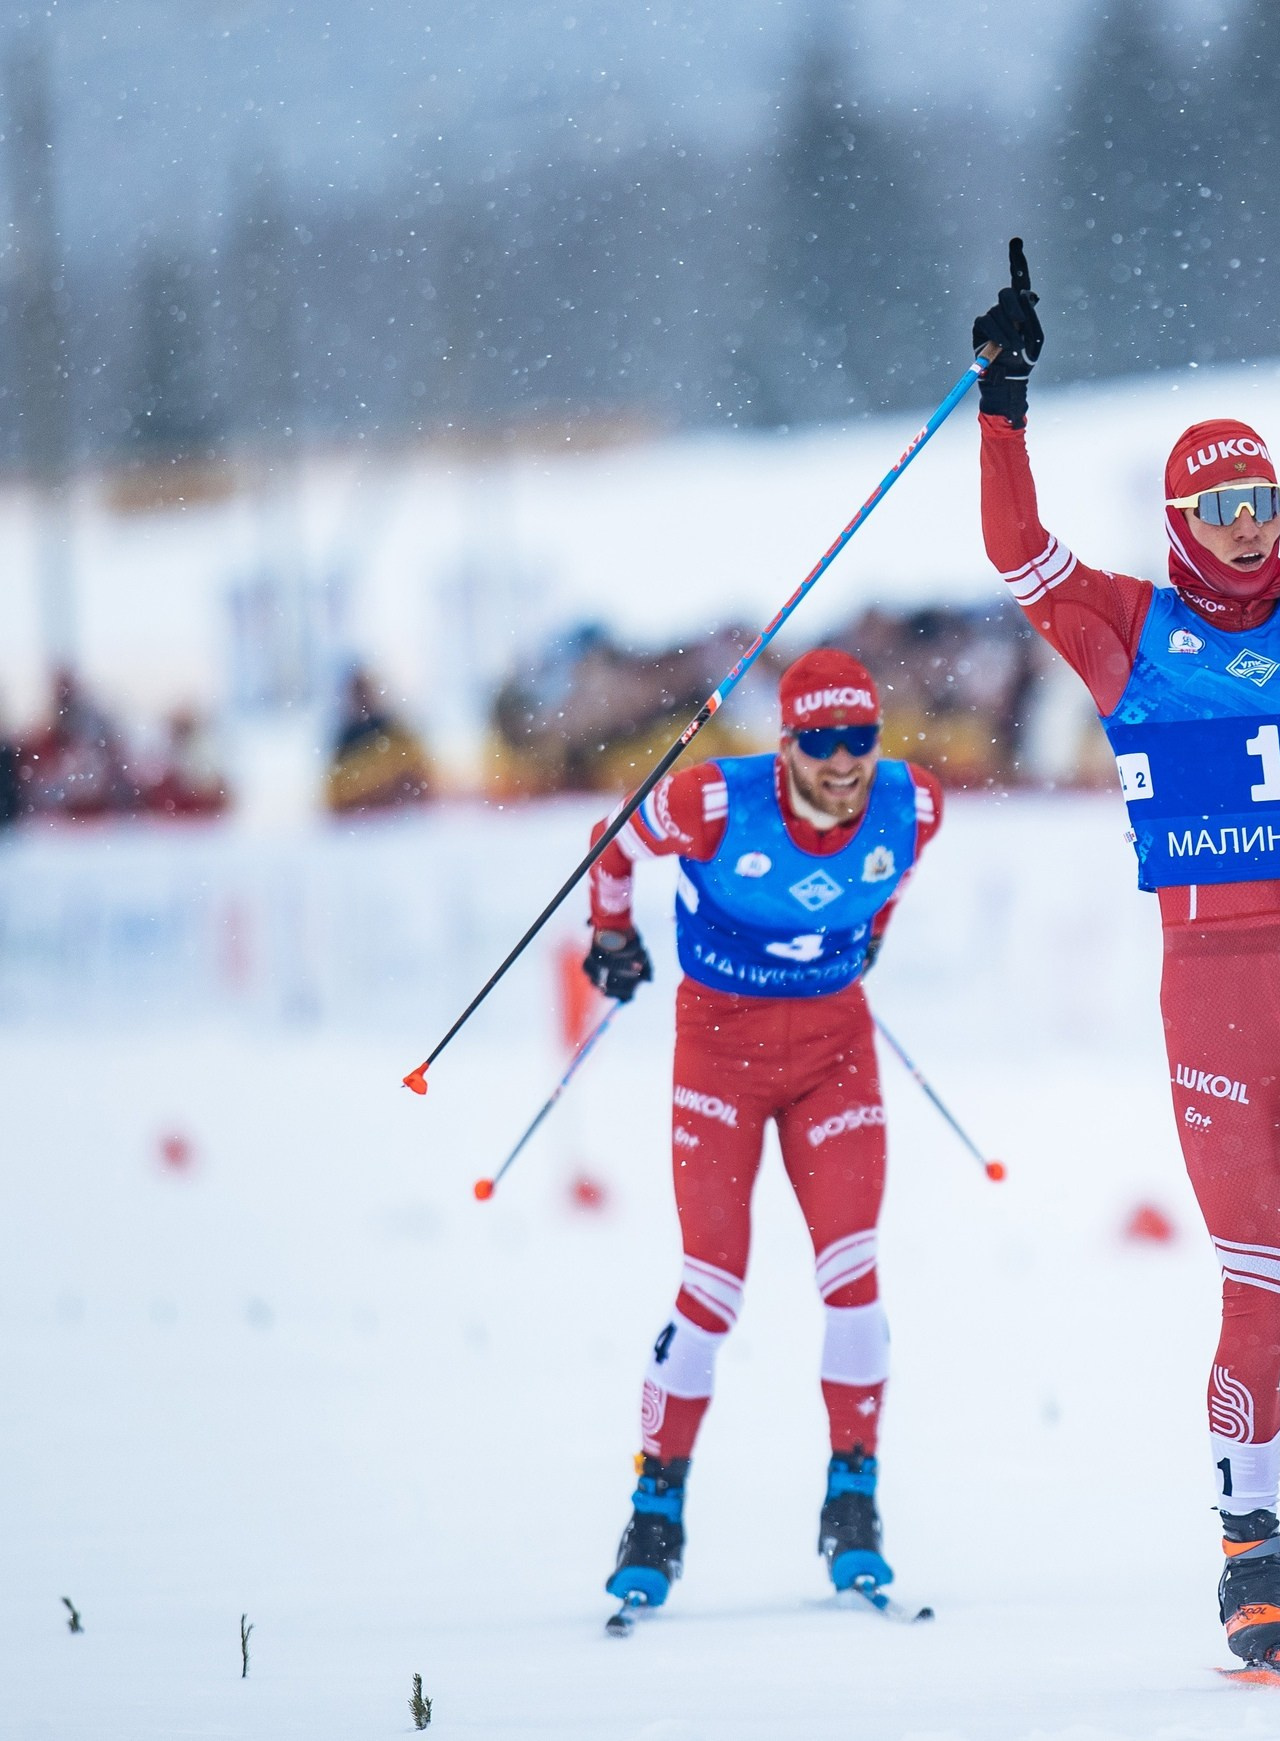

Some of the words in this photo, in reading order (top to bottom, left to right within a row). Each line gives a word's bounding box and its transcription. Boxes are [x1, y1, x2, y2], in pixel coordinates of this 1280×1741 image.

[795, 686, 875, 715] LUKOIL
[1136, 771, 1146, 788] 2
[1176, 1063, 1250, 1105] LUKOIL
[808, 1105, 885, 1147] BOSCO
[1217, 1457, 1232, 1497] 1
